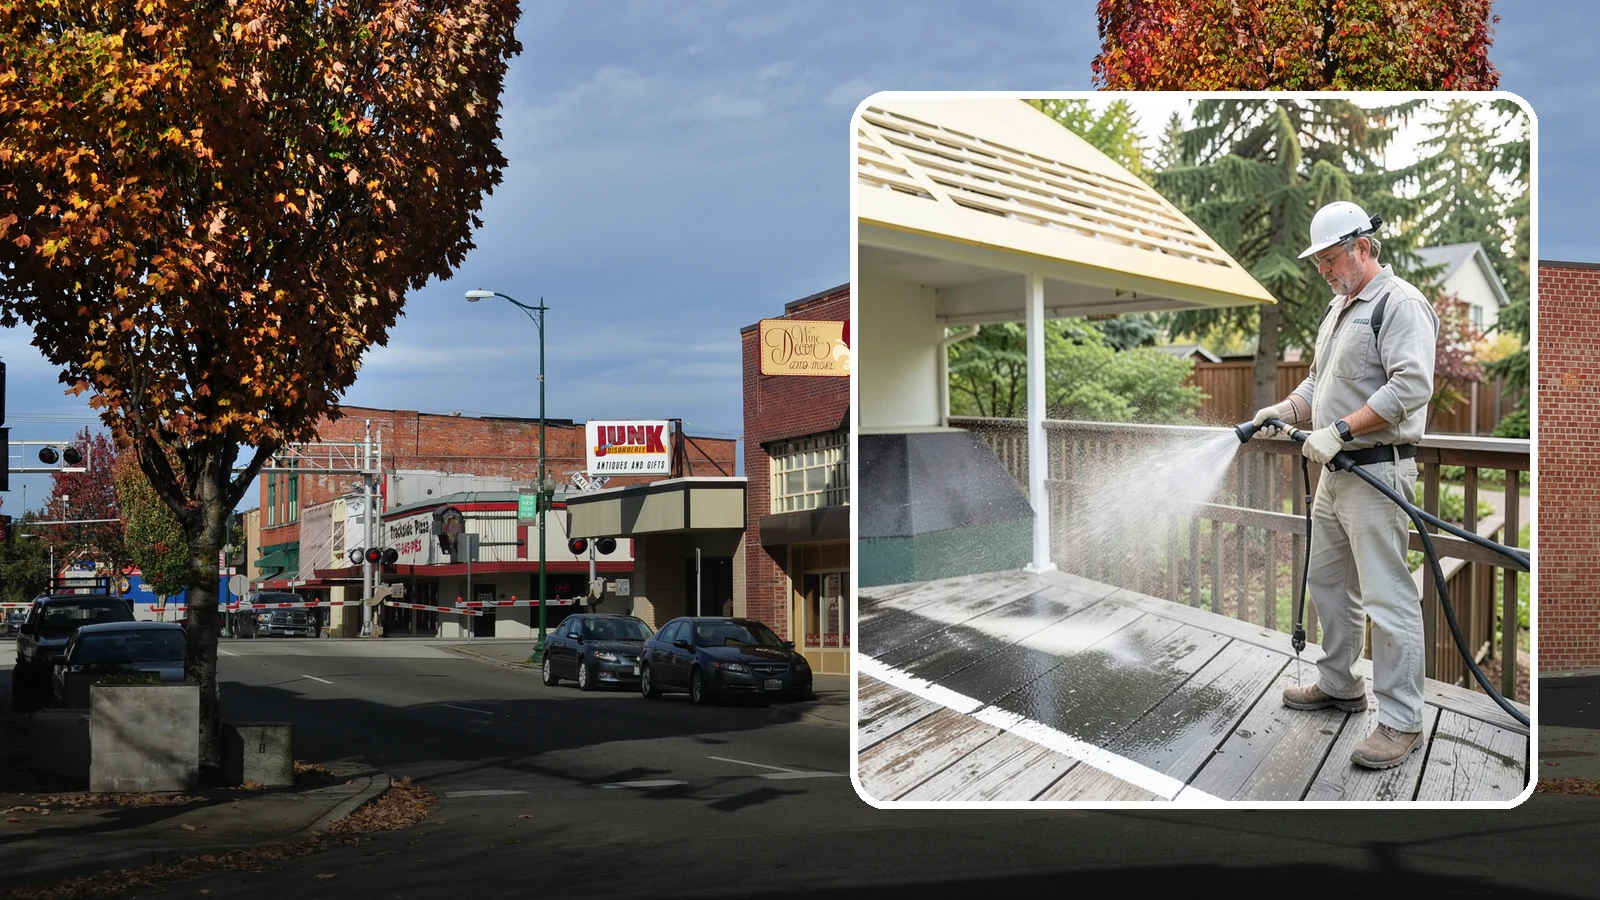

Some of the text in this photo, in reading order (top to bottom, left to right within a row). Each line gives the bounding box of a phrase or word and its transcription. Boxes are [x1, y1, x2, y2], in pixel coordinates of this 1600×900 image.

[596, 425, 665, 457] JUNK
[608, 446, 646, 454] DISORDERLY
[597, 460, 666, 470] ANTIQUES AND GIFTS
[414, 519, 429, 534] Pizza
